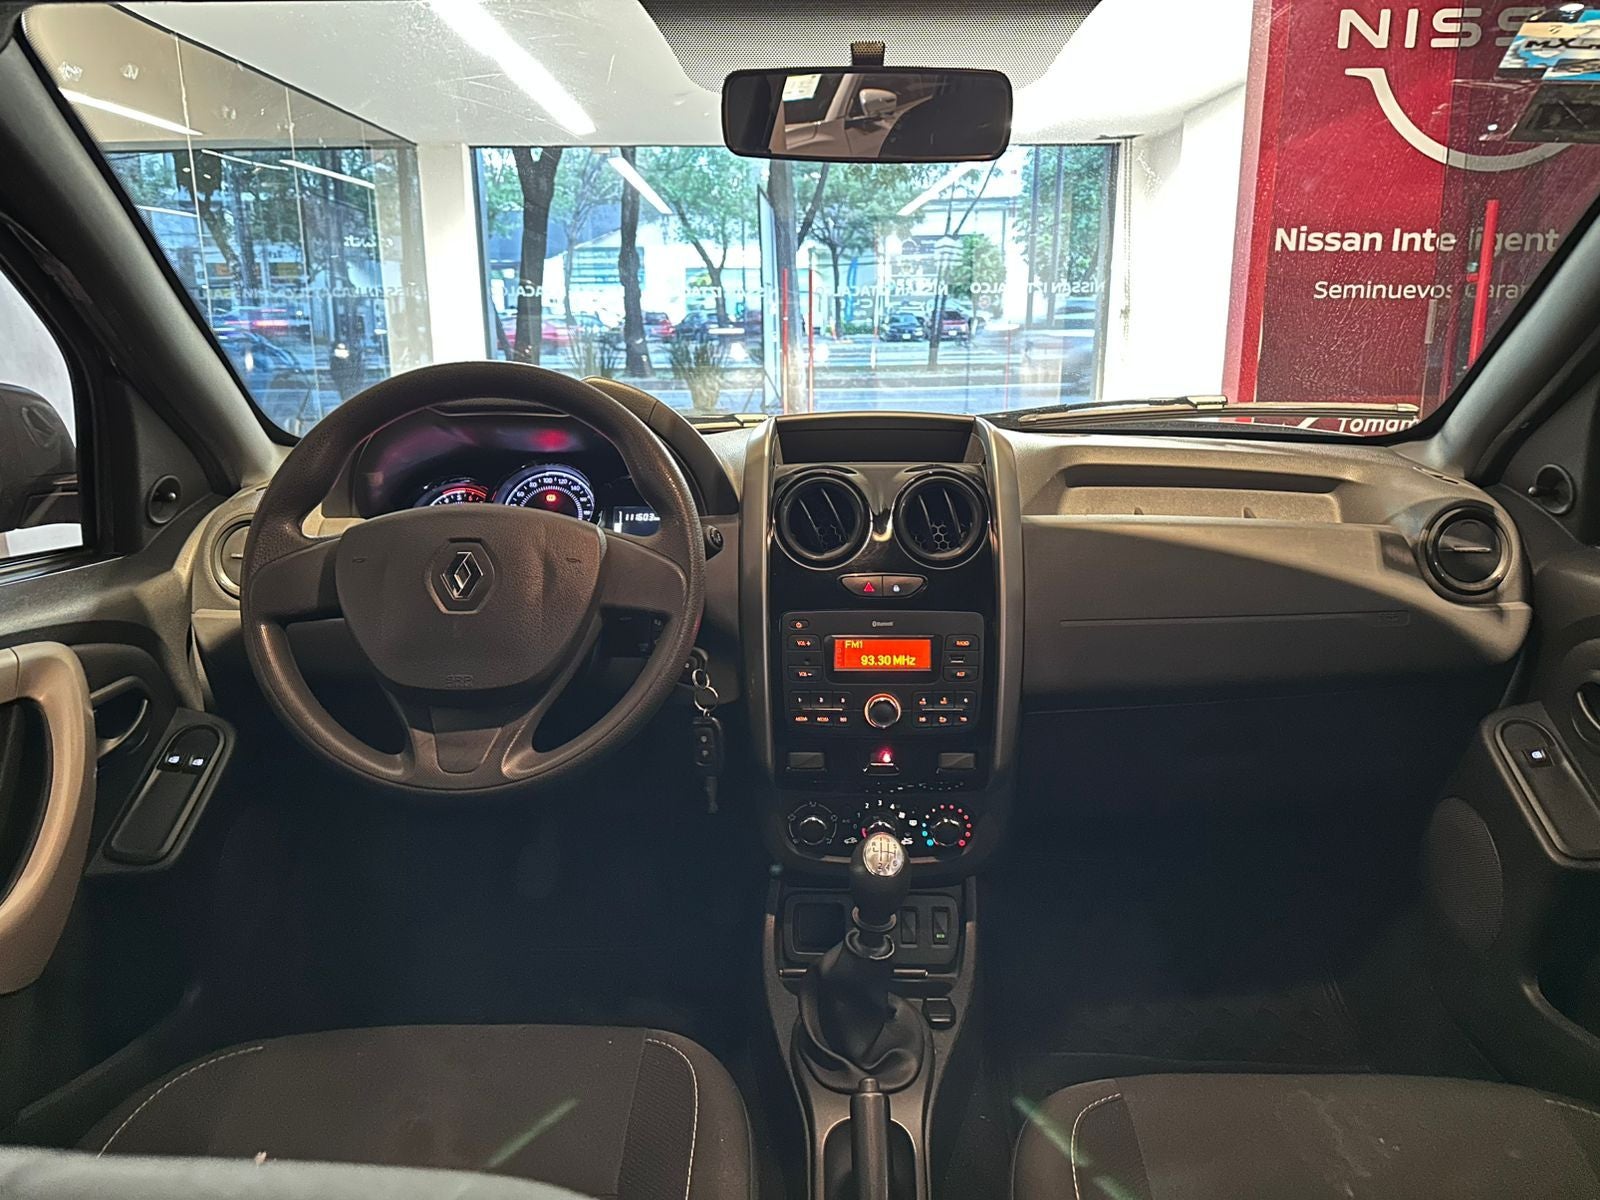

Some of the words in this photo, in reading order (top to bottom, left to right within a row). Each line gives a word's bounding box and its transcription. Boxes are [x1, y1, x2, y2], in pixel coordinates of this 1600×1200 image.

[1337, 8, 1547, 49] NISS
[1274, 226, 1383, 252] Nissan
[1391, 226, 1560, 257] Intelient
[1313, 280, 1453, 299] Seminuevos
[844, 640, 864, 649] FM1
[860, 655, 891, 666] 93.30
[893, 655, 916, 666] MHz
